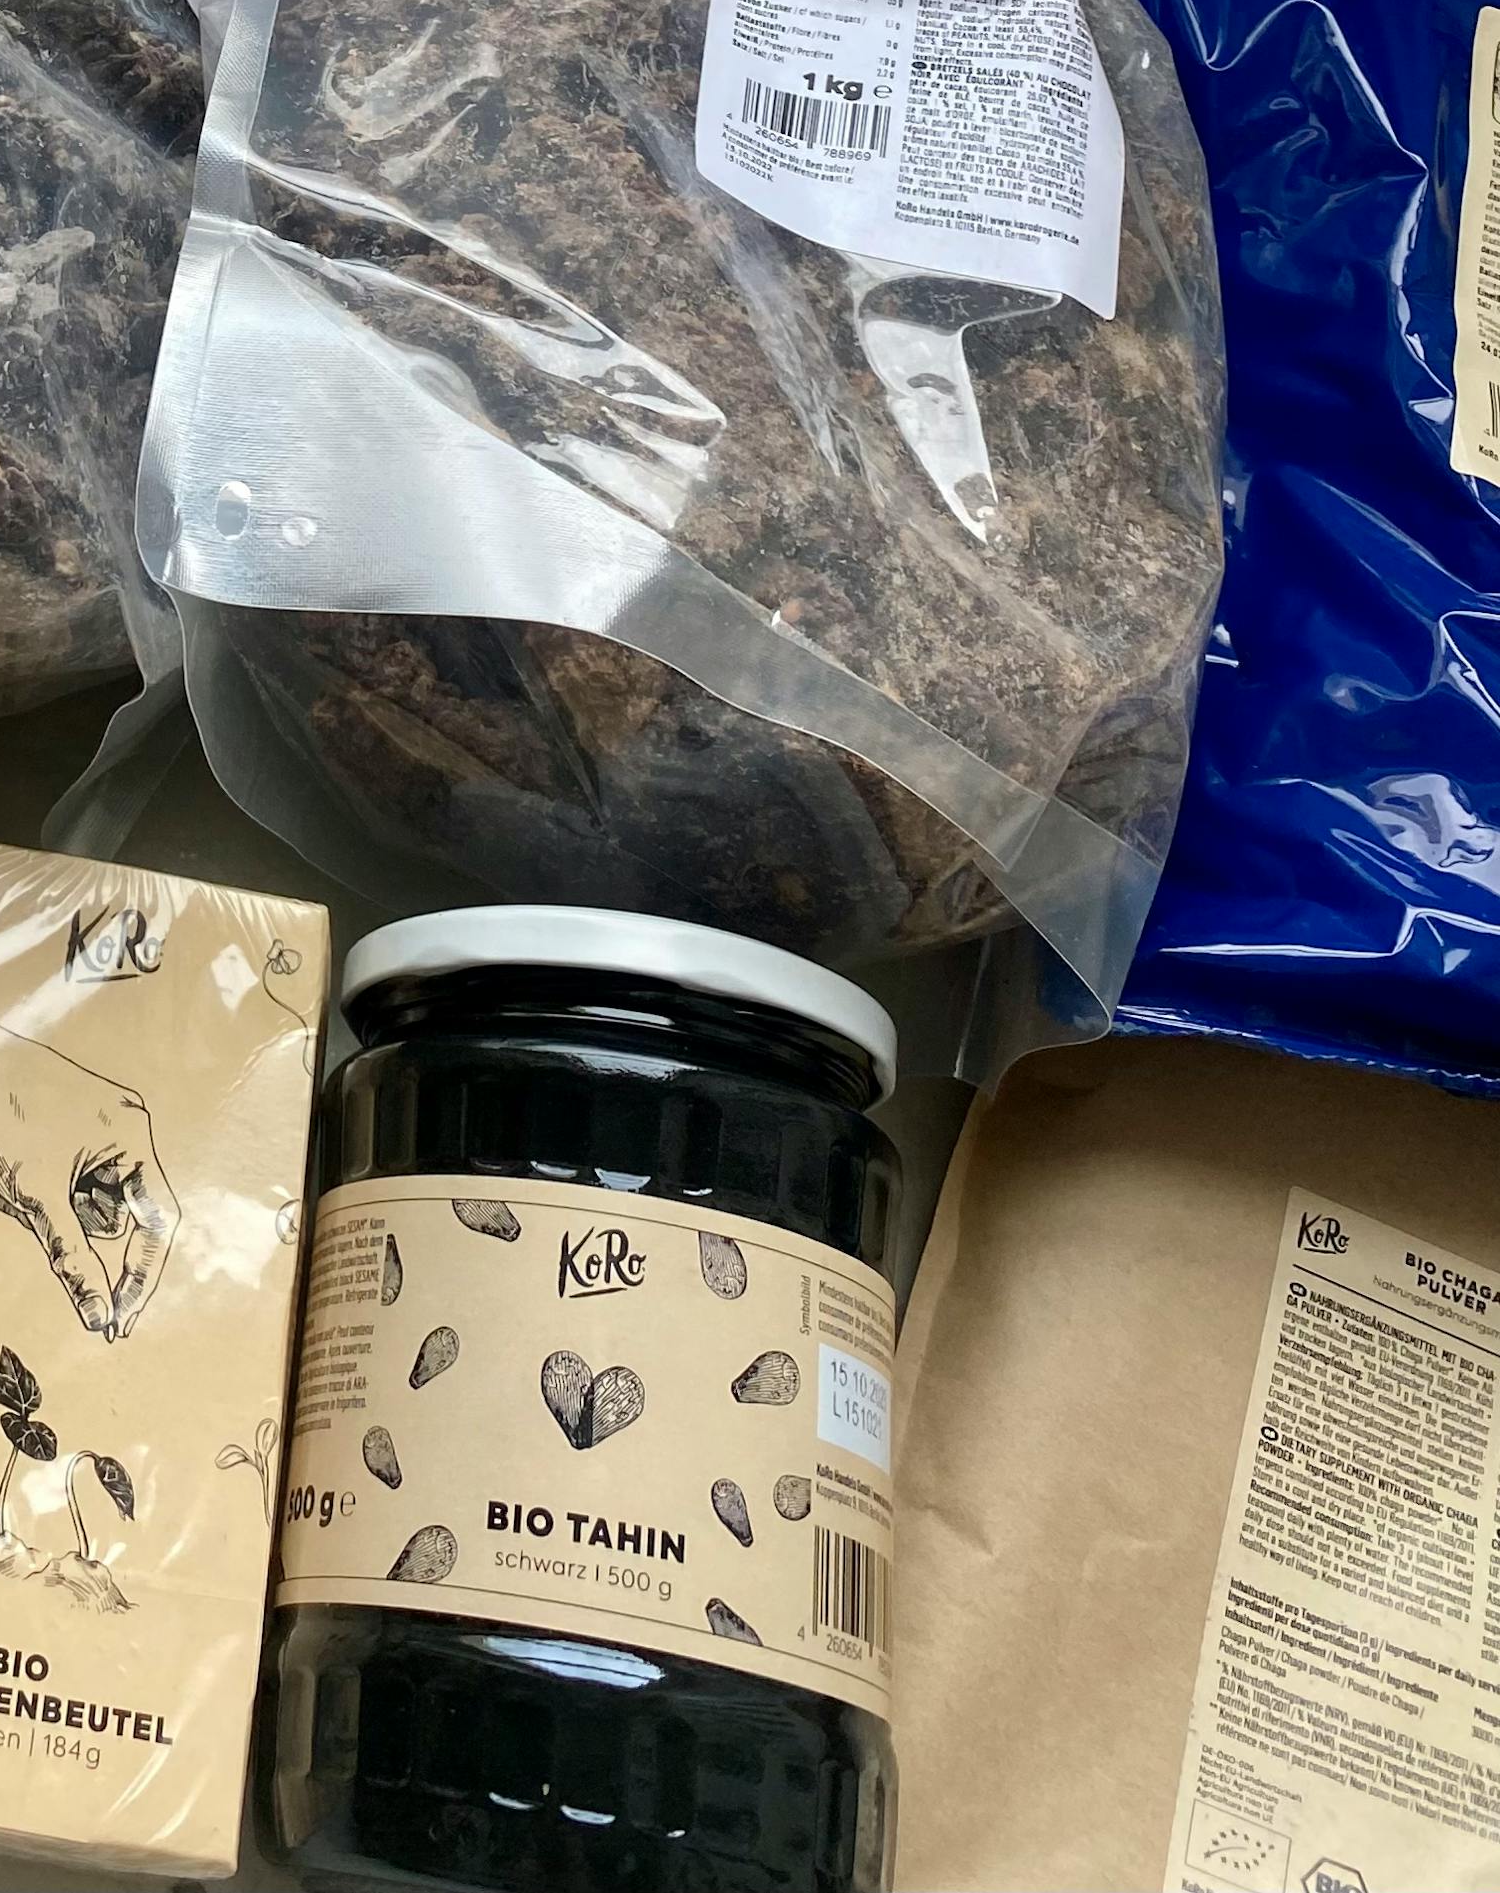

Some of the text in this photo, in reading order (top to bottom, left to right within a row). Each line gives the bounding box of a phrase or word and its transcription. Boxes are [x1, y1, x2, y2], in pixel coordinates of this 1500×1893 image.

[802, 71, 865, 101] 1 kg
[754, 126, 873, 162] 260654 788969
[65, 905, 166, 983] KoRo
[1297, 1212, 1350, 1254] KoRo
[558, 1227, 647, 1299] KoRo
[1405, 1252, 1500, 1304] BIO CHAGA
[800, 1275, 813, 1336] Symbolbild
[1417, 1274, 1488, 1316] PULVER
[1258, 1439, 1294, 1463] POWDER
[1250, 1478, 1312, 1515] Recommended
[1280, 1436, 1479, 1529] DIETARY SUPPLEMENT ORGANIC CHAGA
[318, 1489, 335, 1528] g
[487, 1500, 686, 1564] BIO TAHIN
[495, 1550, 672, 1602] schwarz 500 g
